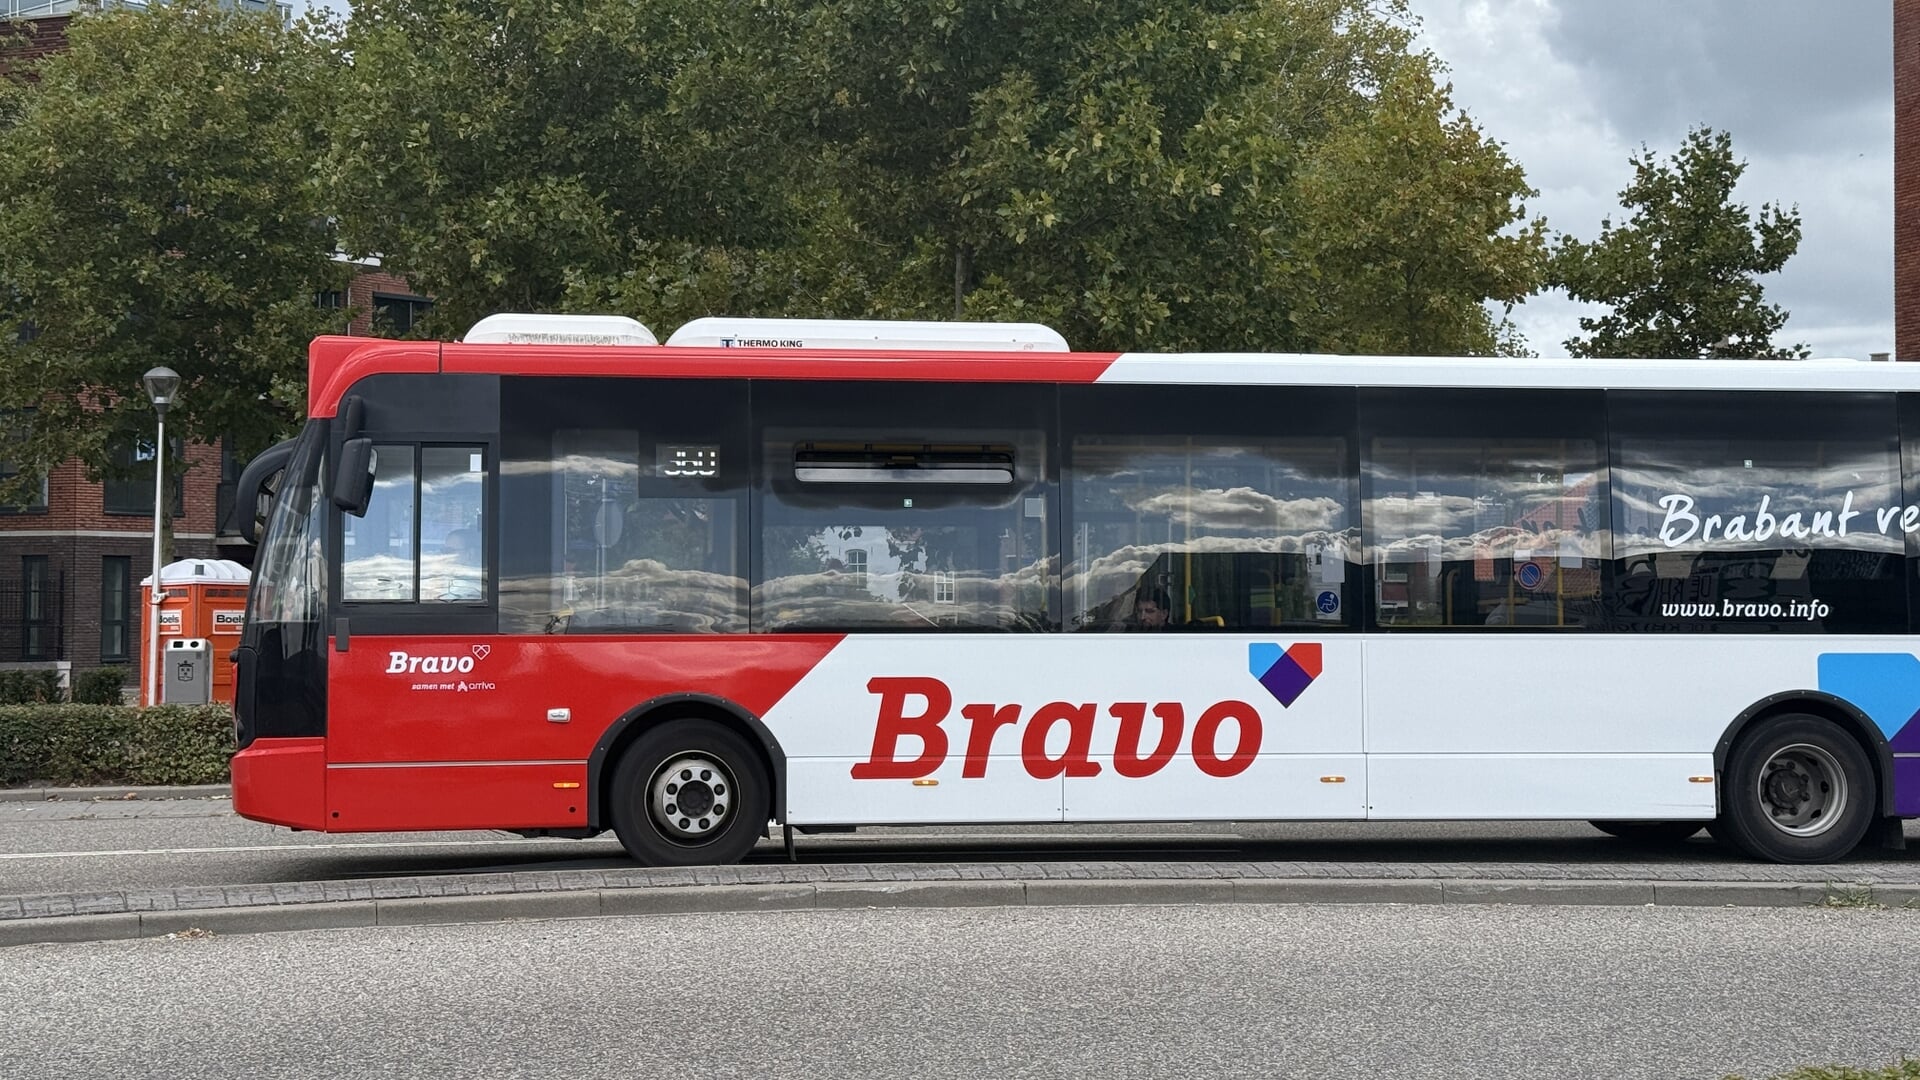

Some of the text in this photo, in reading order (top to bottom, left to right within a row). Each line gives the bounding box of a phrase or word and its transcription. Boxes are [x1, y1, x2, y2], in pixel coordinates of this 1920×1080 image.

[737, 339, 778, 348] THERMO
[780, 340, 803, 348] KING
[1658, 490, 1860, 547] Brabant
[1661, 599, 1829, 620] www.bravo.info
[385, 651, 475, 674] Bravo
[439, 682, 455, 690] met
[850, 676, 1264, 780] Bravo
